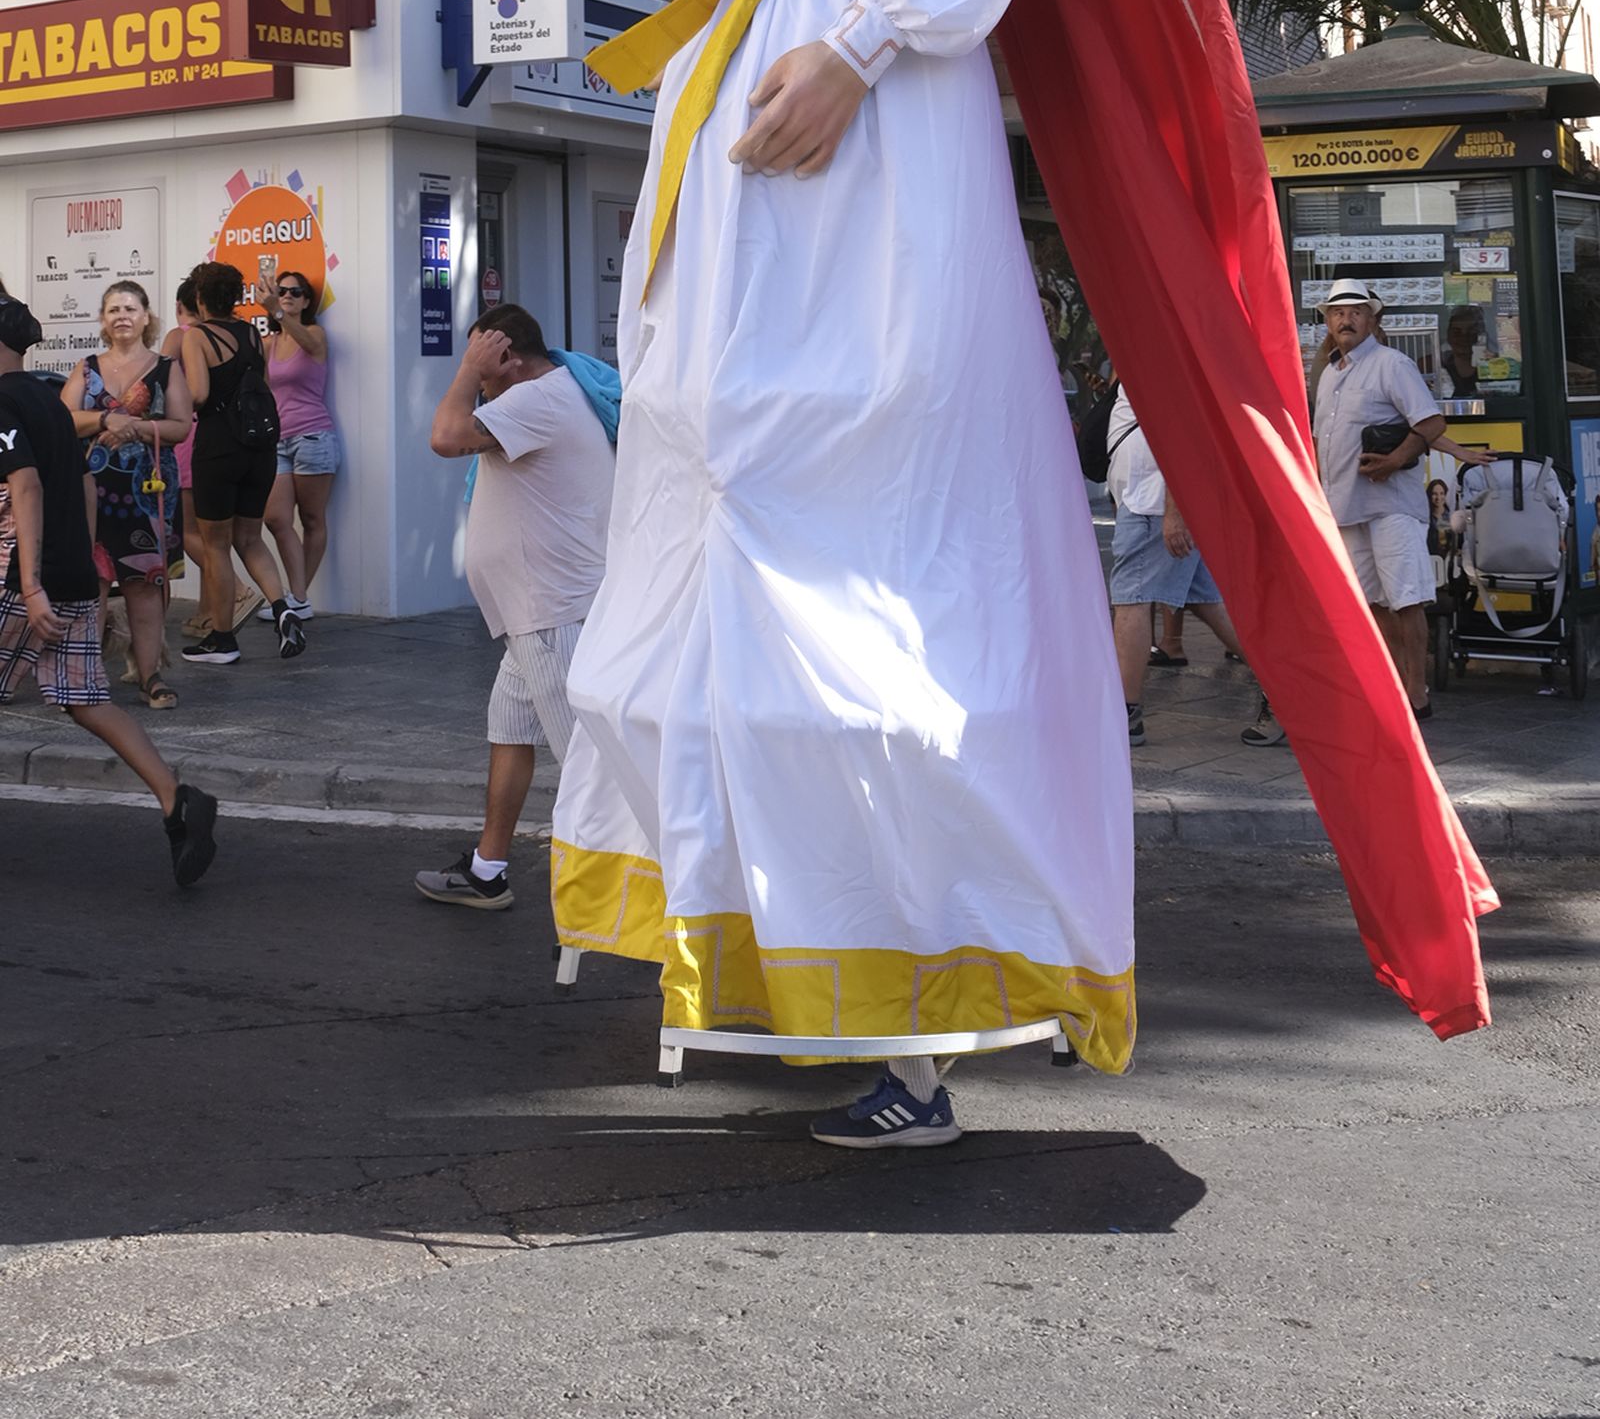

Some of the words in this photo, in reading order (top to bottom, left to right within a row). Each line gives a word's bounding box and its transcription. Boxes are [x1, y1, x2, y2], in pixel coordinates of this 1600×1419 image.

[490, 18, 527, 30] Loterías
[530, 19, 536, 29] y
[255, 24, 344, 49] TABACOS
[490, 32, 533, 43] Apuestas
[536, 28, 551, 39] del
[490, 43, 522, 53] Estado
[150, 70, 179, 86] EXP.
[201, 65, 219, 80] 24
[1465, 131, 1499, 144] EURO
[1455, 142, 1511, 158] JACKPOT
[67, 198, 123, 237] QUEMADERO
[36, 273, 68, 282] TABACOS
[69, 333, 100, 349] Fumador
